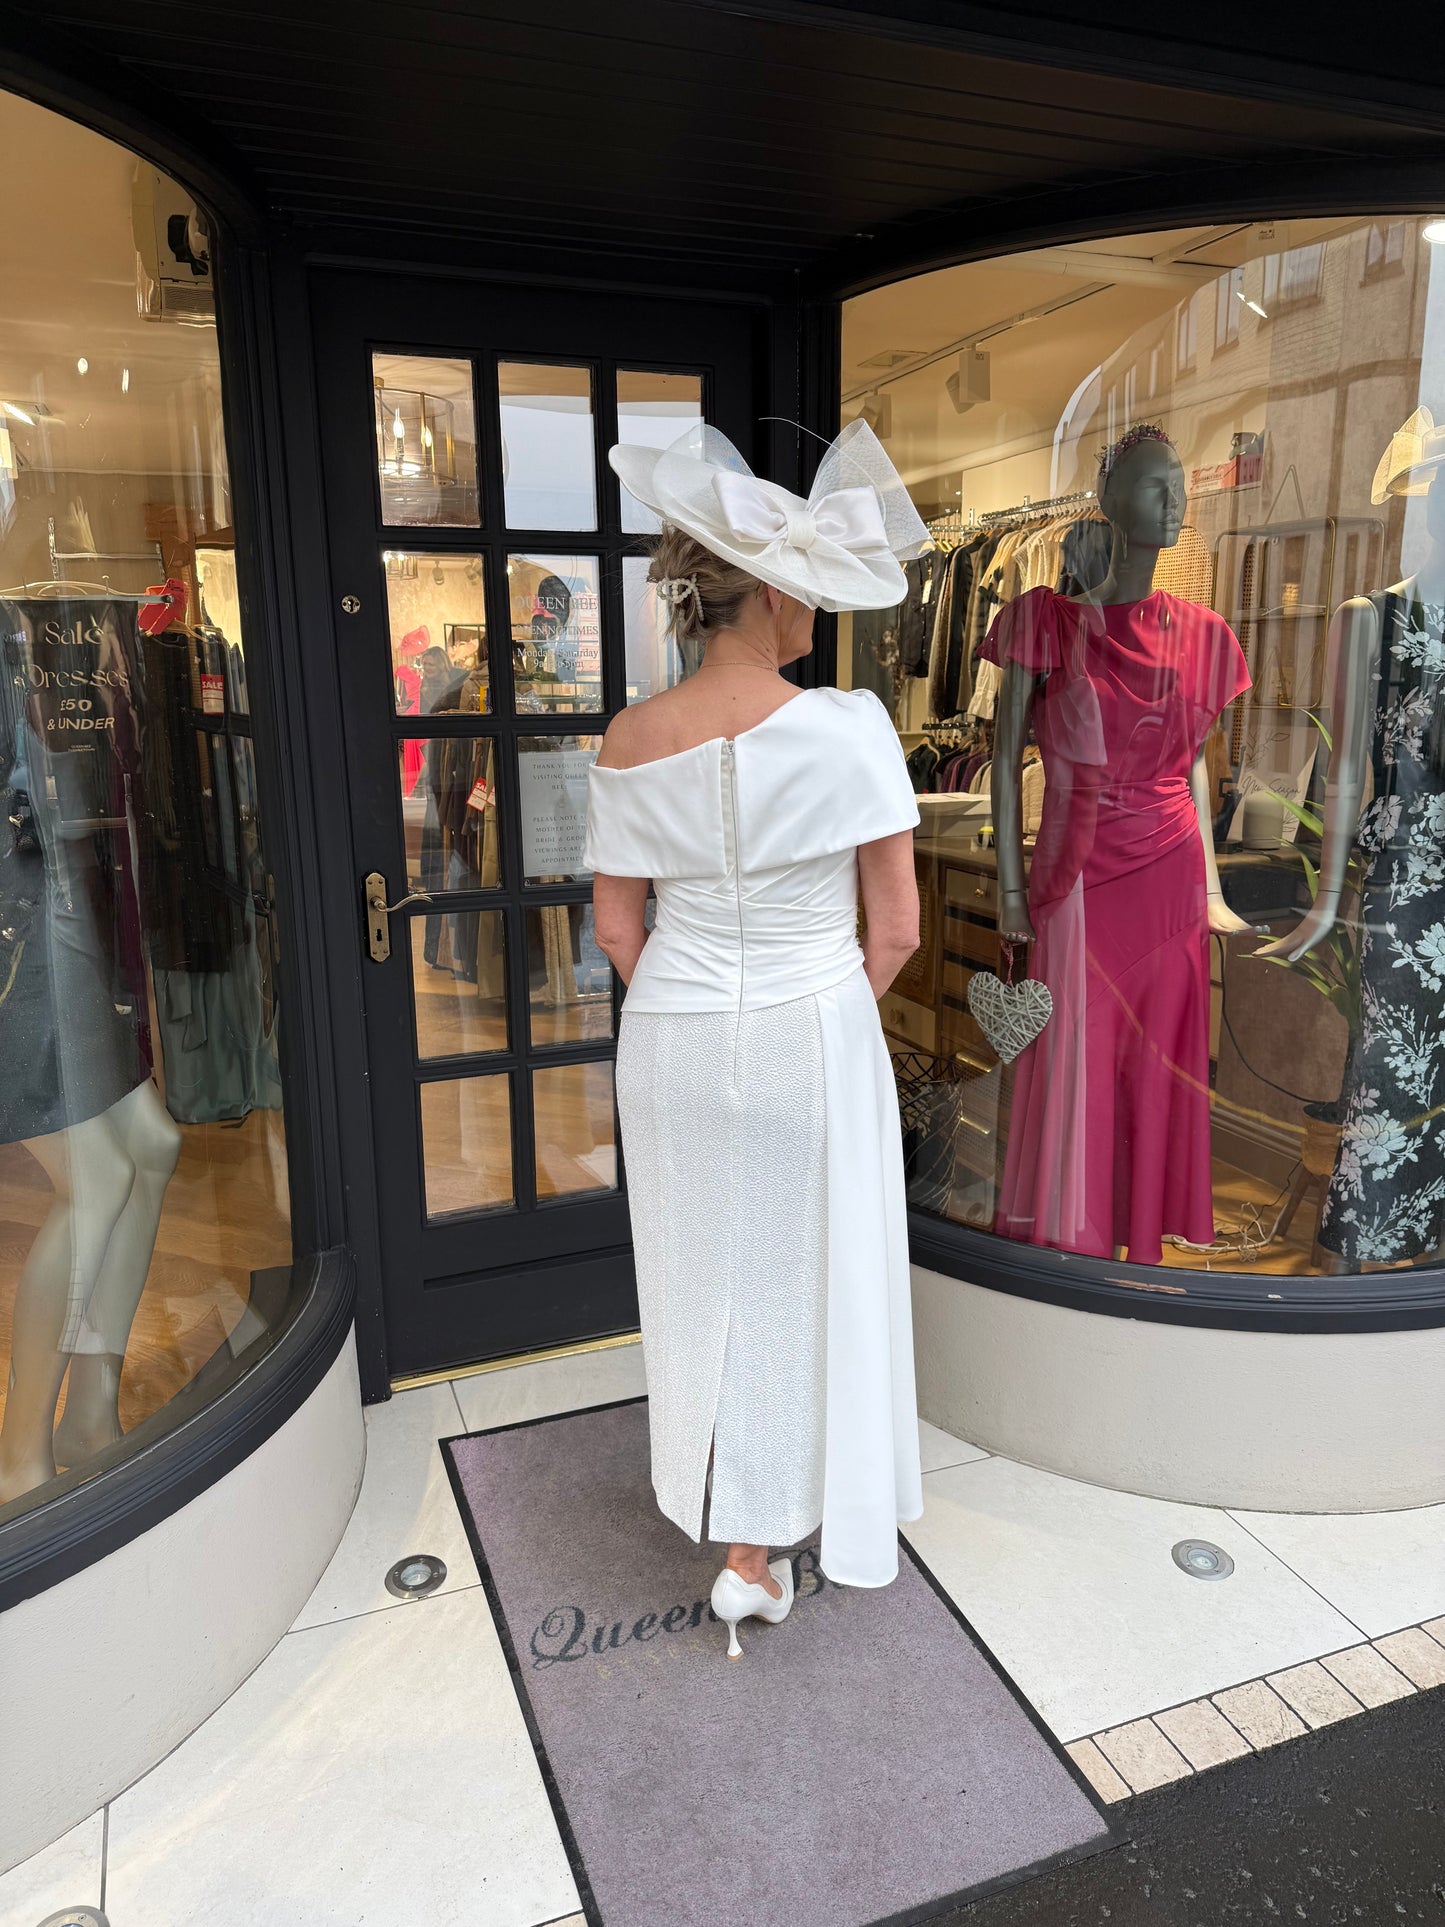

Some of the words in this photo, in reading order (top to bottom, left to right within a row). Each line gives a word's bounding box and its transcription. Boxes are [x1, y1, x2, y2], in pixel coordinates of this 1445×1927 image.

[513, 596, 565, 610] QUEEN
[45, 620, 105, 645] Sale
[23, 664, 129, 688] Dresses
[202, 681, 224, 690] SALE
[60, 699, 93, 712] £50
[47, 719, 56, 731] &
[58, 717, 115, 730] UNDER
[529, 1598, 722, 1671] Queen
